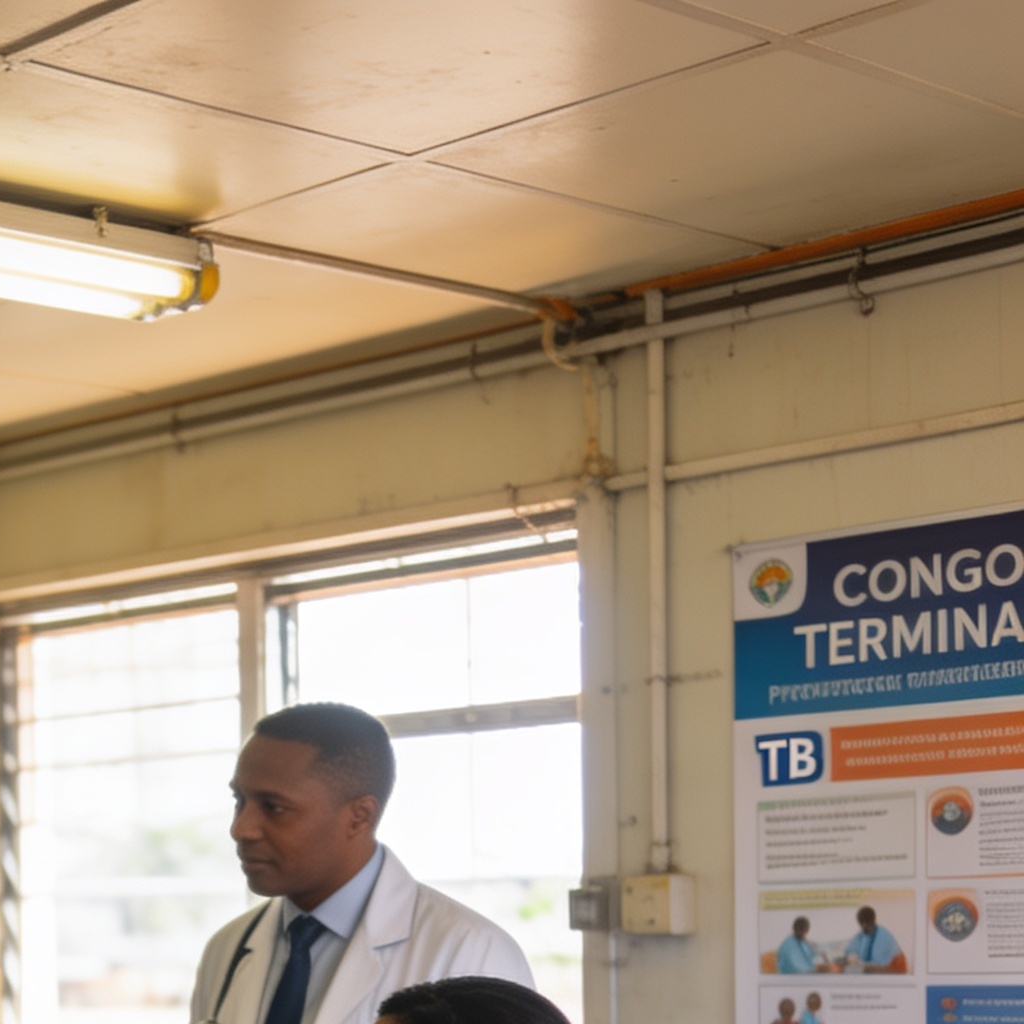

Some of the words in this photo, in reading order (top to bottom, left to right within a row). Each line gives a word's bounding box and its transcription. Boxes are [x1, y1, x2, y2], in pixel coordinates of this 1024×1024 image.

[832, 542, 1024, 607] CONGO
[793, 600, 1024, 669] TERMINA
[758, 738, 817, 782] TB
